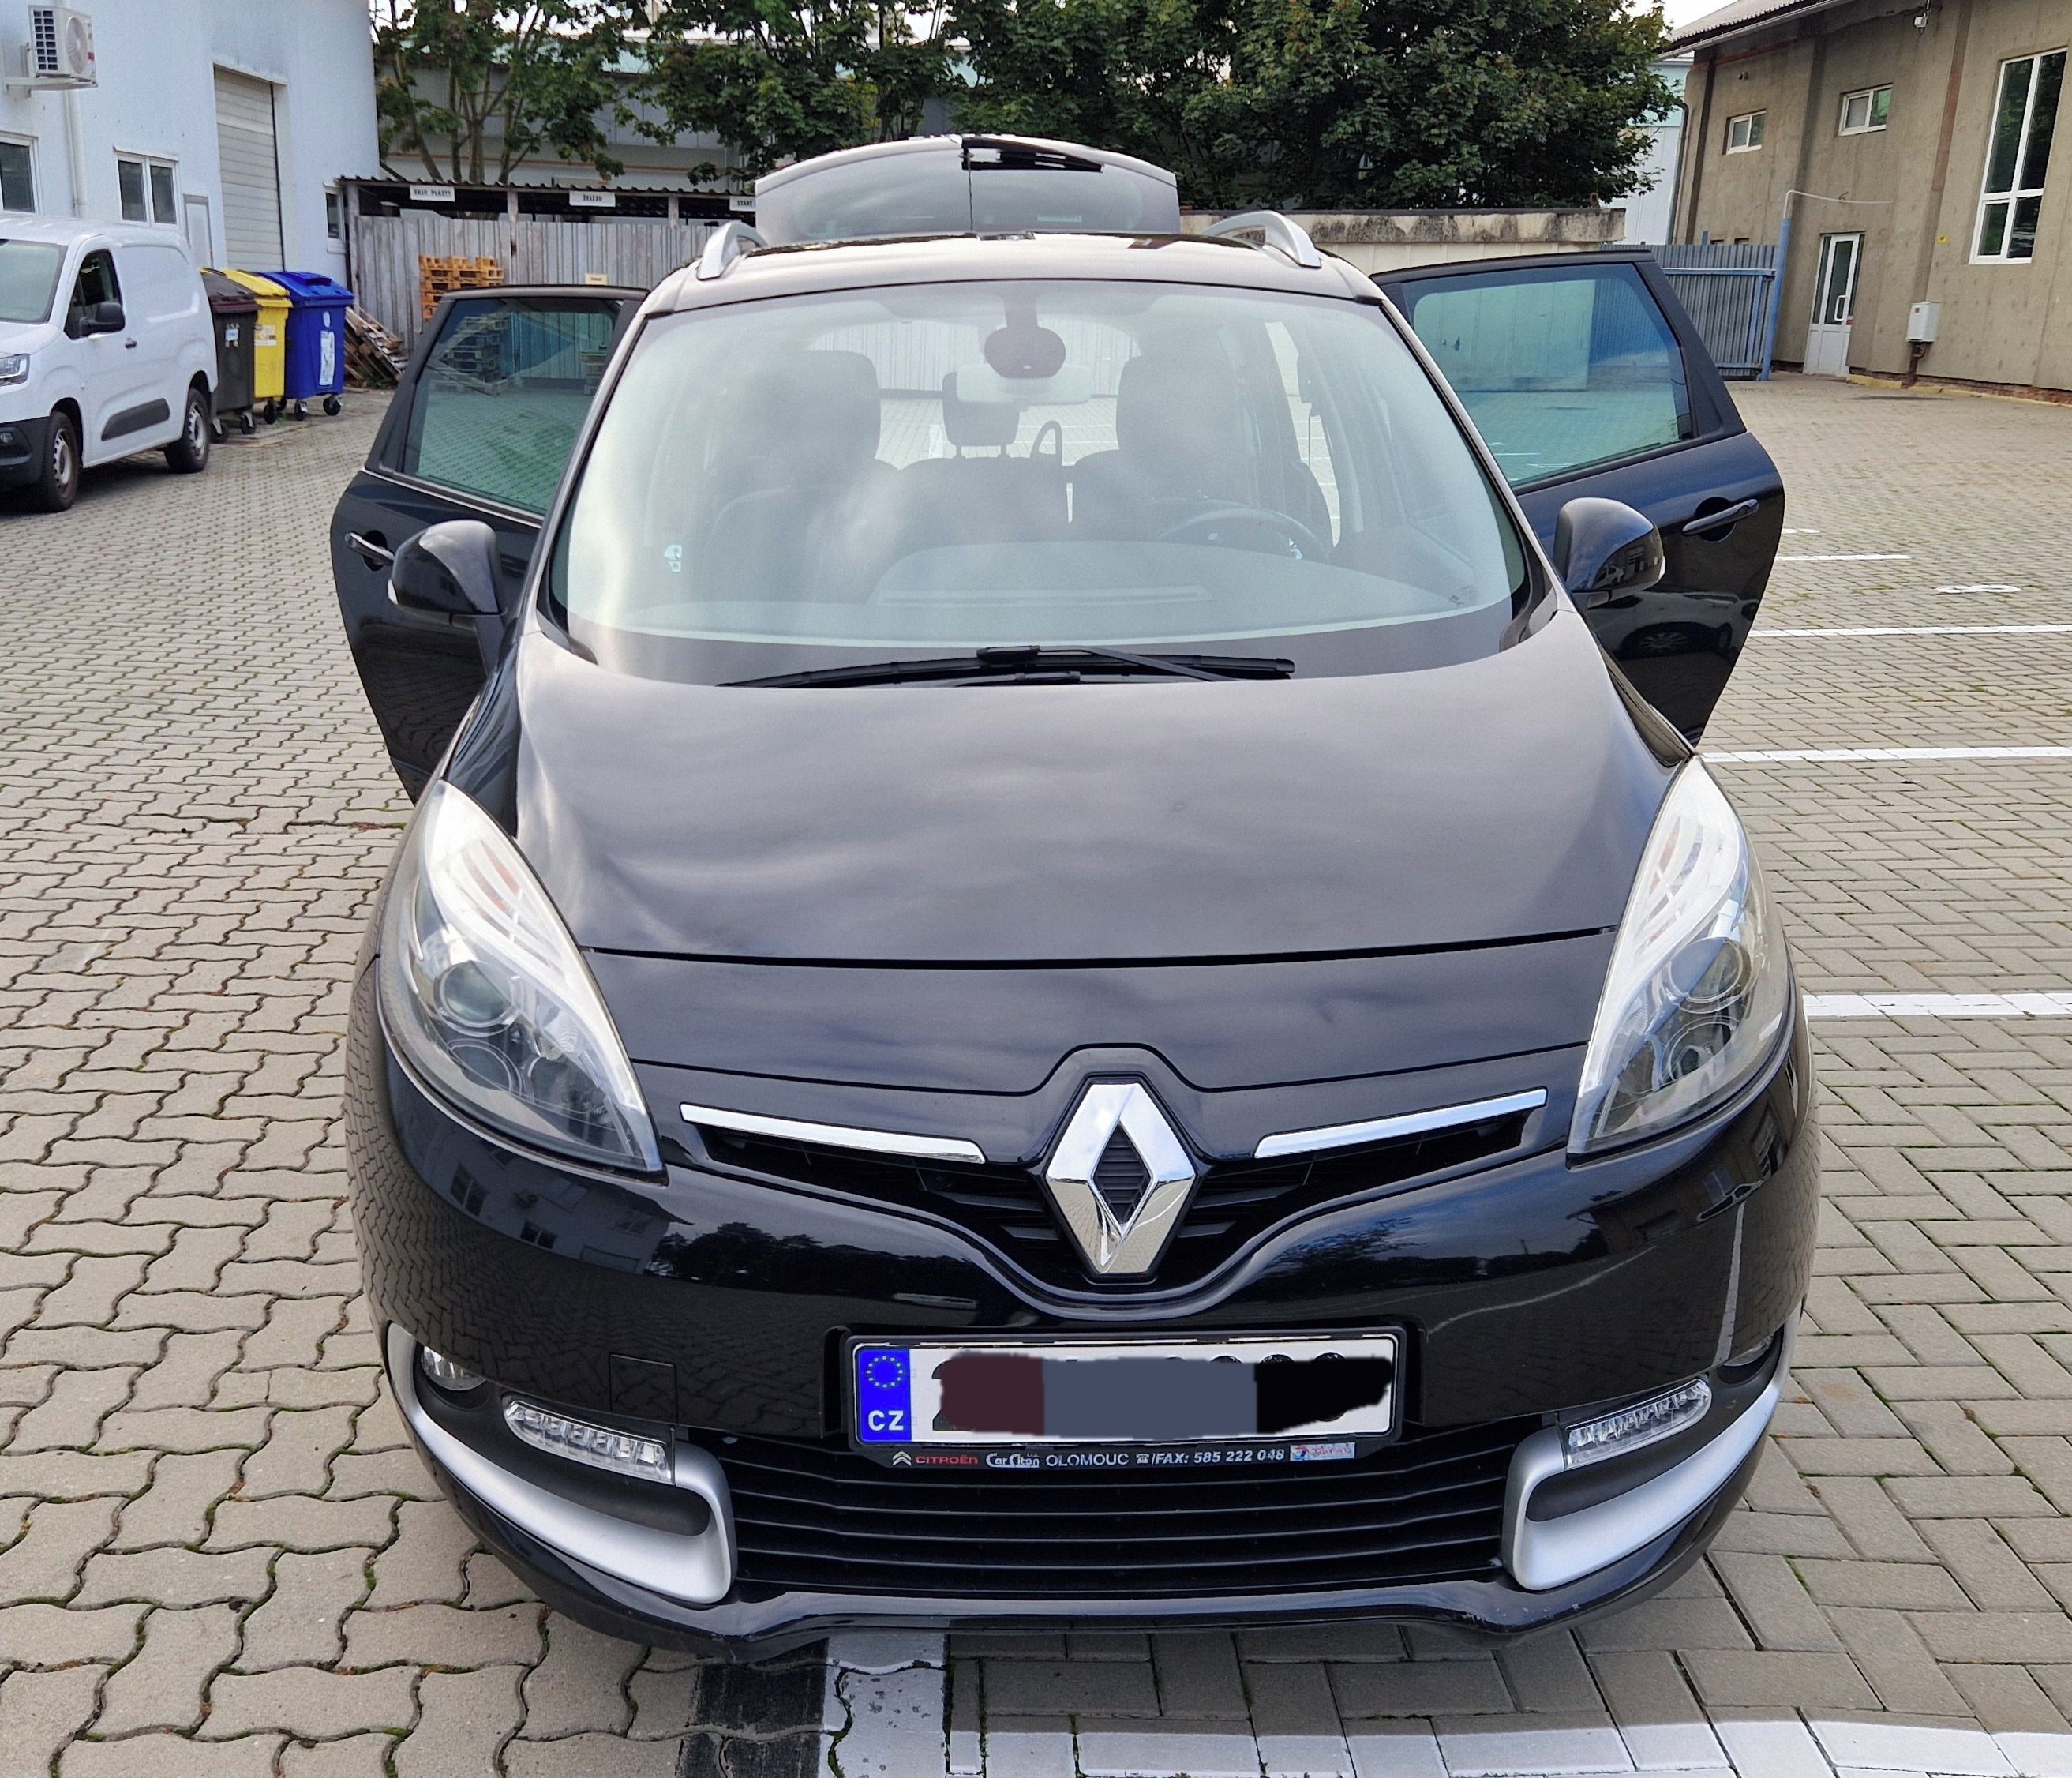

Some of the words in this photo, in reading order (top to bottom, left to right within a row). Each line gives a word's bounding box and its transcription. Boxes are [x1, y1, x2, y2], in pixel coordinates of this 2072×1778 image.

[868, 1410, 904, 1431] CZ
[1046, 1453, 1129, 1466] OLOMOUC
[1193, 1451, 1221, 1463] 585
[1225, 1450, 1253, 1462] 222
[1257, 1449, 1284, 1461] 048
